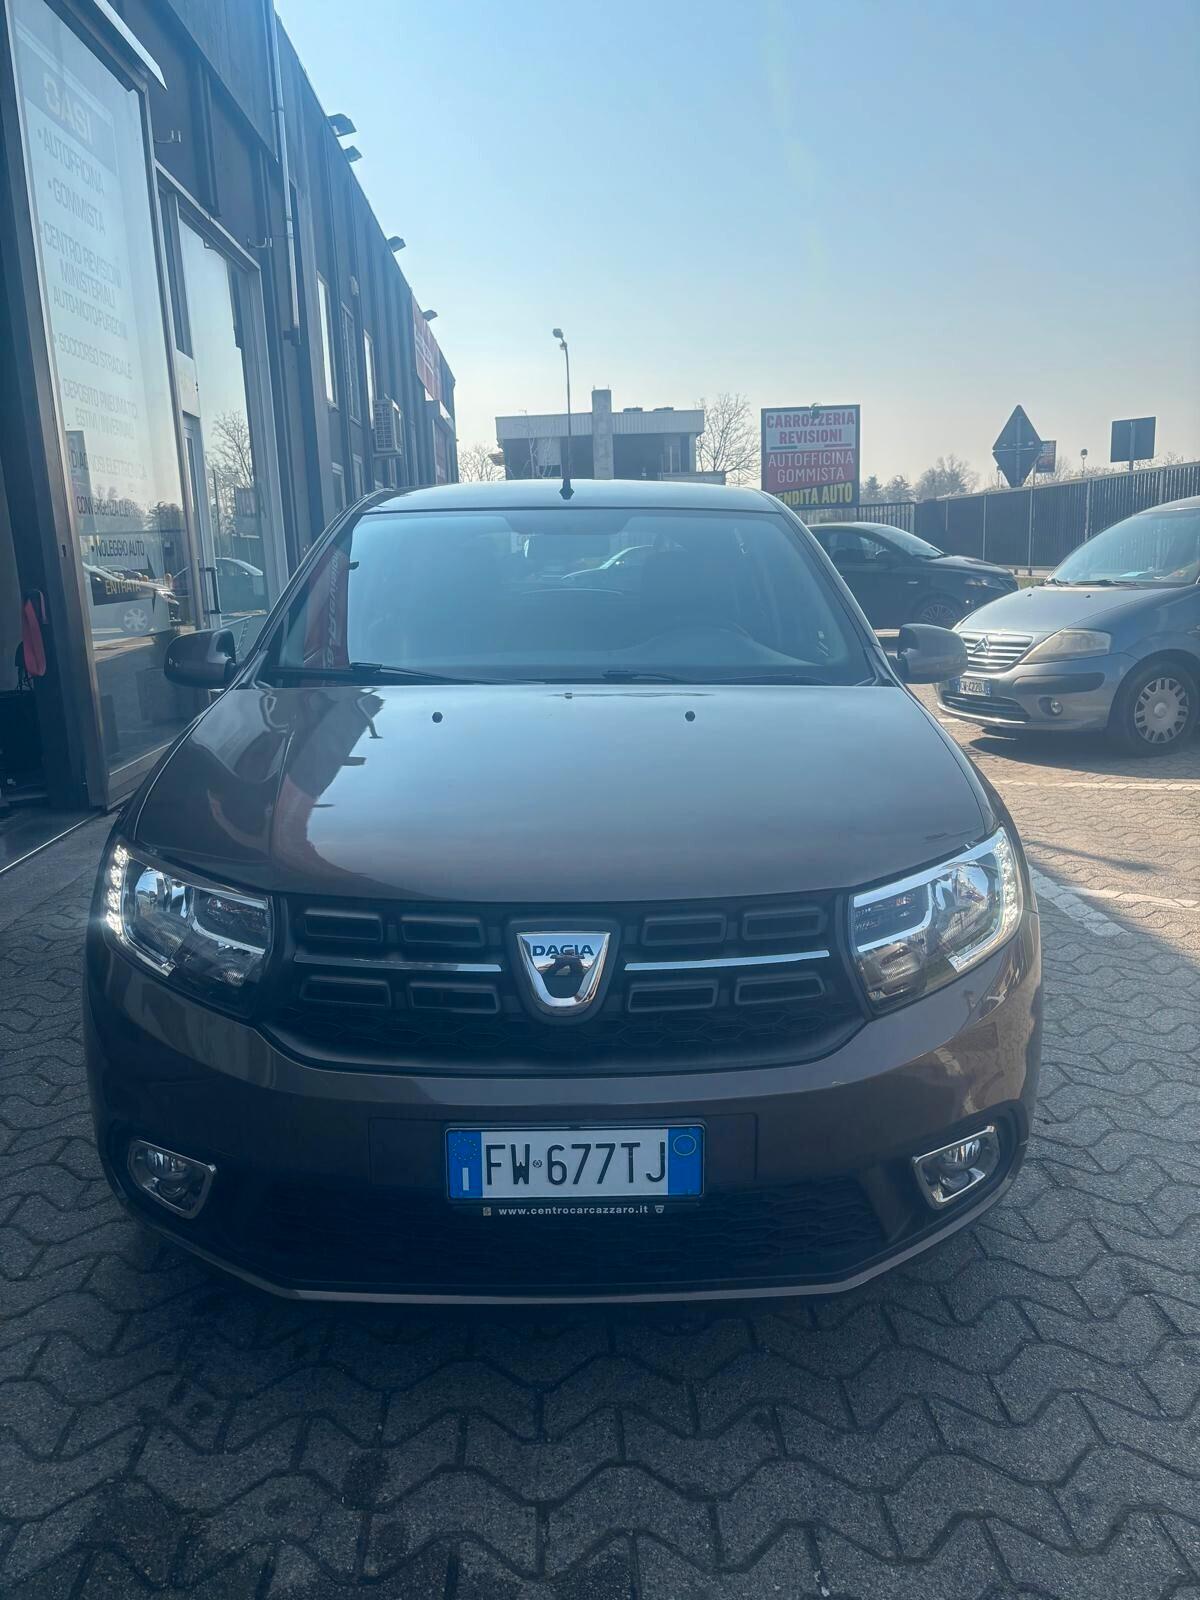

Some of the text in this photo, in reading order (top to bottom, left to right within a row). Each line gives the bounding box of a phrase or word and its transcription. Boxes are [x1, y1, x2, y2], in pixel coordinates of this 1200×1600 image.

[43, 127, 105, 196] AUTOFFICINA
[52, 177, 106, 236] GOMMISTA
[43, 220, 82, 264] CENTRO
[58, 332, 98, 366] SOCCORSO
[766, 411, 855, 429] CARROZZERIA
[779, 429, 843, 444] REVISIONI
[768, 451, 854, 468] AUTOFFICINA
[777, 466, 845, 484] GOMMISTA
[821, 482, 853, 504] AUTO
[95, 539, 144, 557] NOLEGGIO AUTO
[104, 578, 141, 595] ENTRATA
[498, 1205, 649, 1216] www.centrocarcazzaro.it
